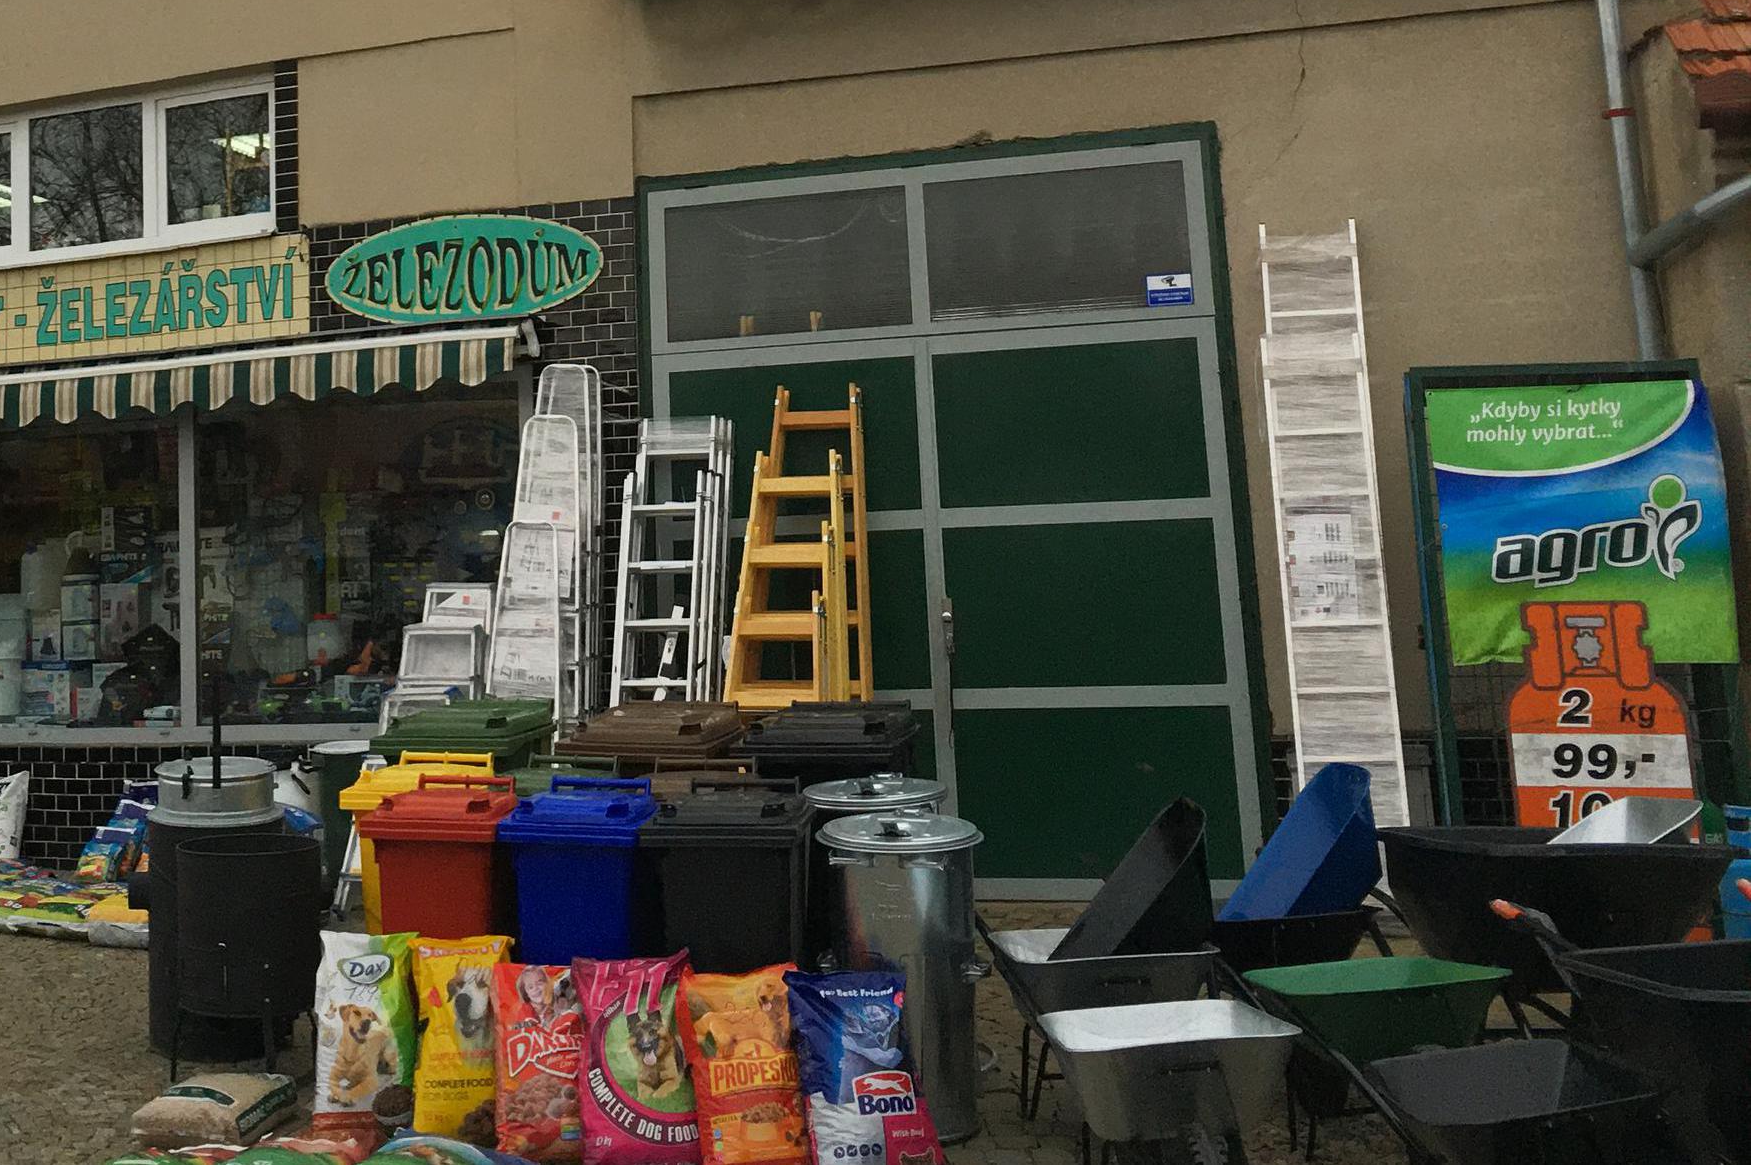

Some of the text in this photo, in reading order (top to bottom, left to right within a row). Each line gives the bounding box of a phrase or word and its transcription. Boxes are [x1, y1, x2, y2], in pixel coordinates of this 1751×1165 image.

[342, 229, 591, 314] ŽELEZODŮM
[37, 246, 296, 346] ŽELEZÁŘSTVÍ
[1546, 402, 1562, 418] si
[1567, 398, 1621, 422] kytky
[1466, 422, 1527, 446] mohly
[1557, 687, 1657, 729] 2 kg
[349, 960, 385, 977] Dax
[860, 986, 894, 997] Friend
[588, 1067, 699, 1143] COMPLETE DOG FOOD
